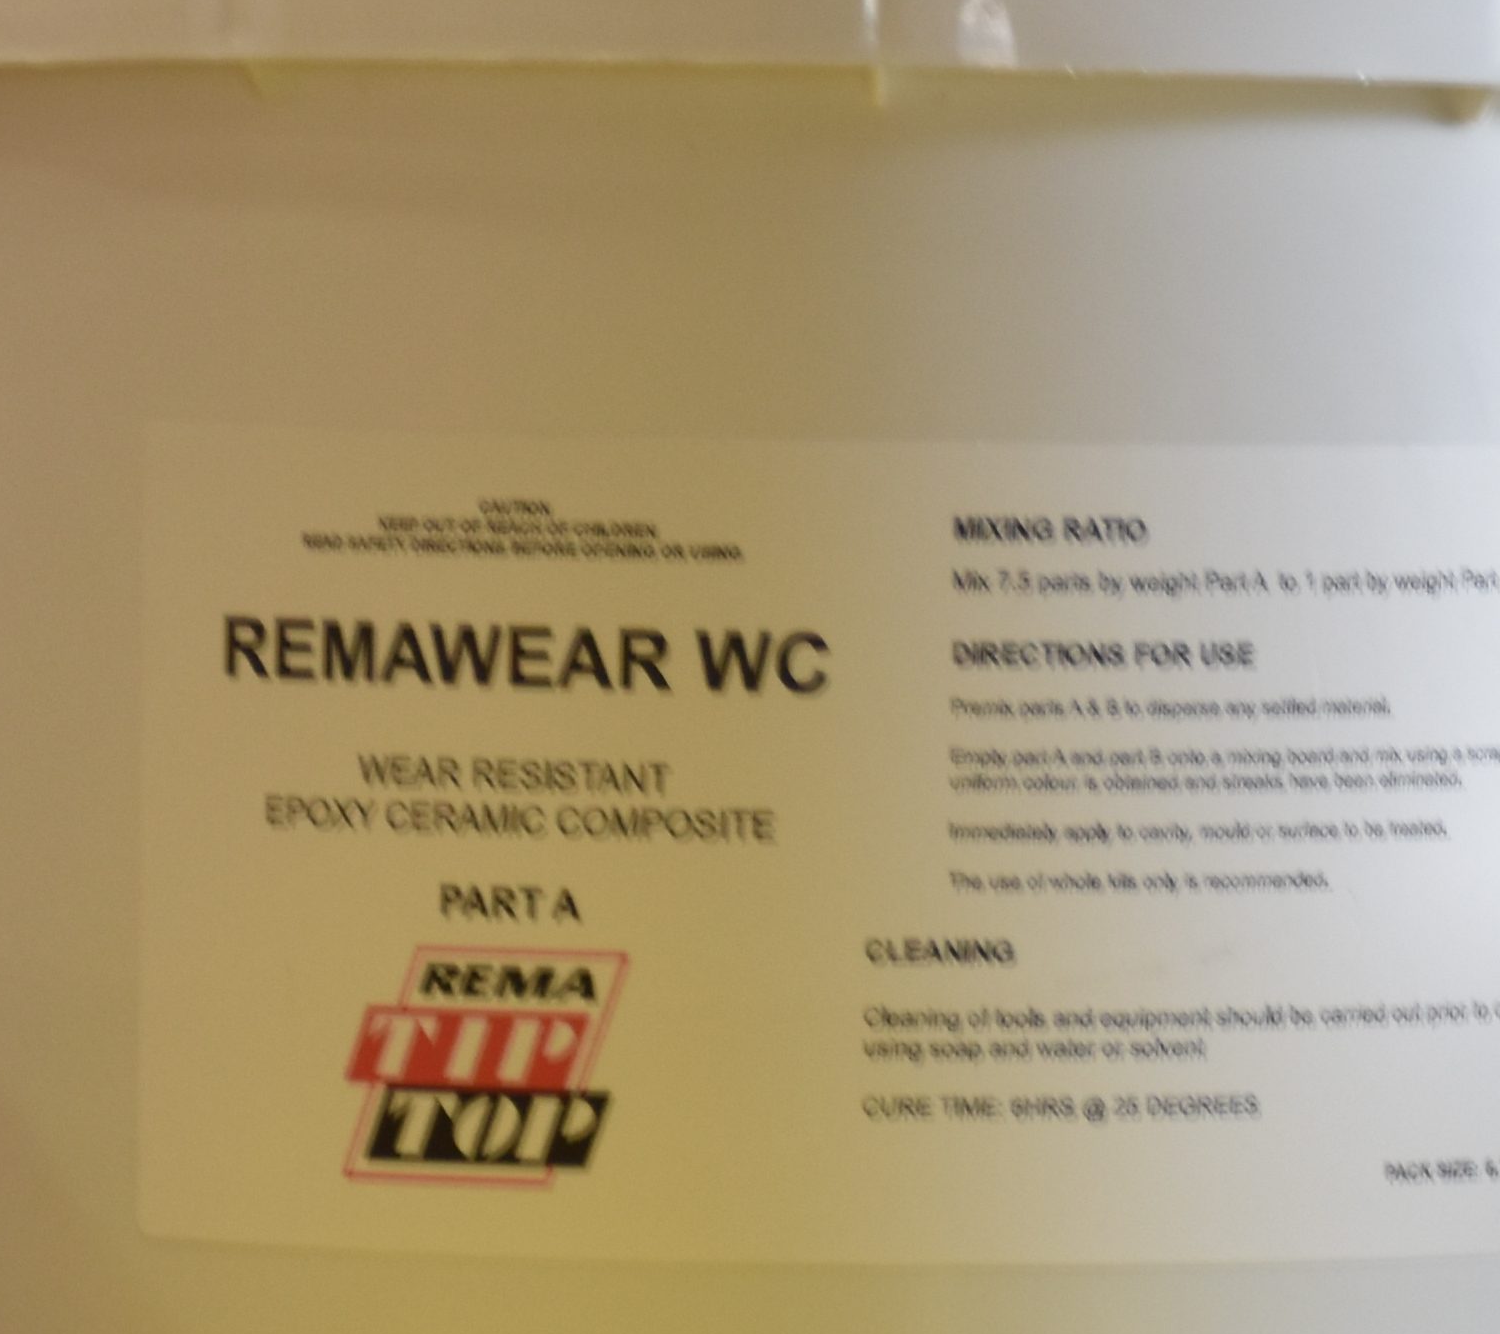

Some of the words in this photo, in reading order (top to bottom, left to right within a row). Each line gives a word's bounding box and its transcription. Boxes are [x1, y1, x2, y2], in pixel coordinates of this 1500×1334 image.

[952, 514, 1056, 544] MIXING
[1062, 514, 1150, 546] RATIO
[951, 569, 992, 597] Mix
[1037, 568, 1094, 597] parts
[1097, 568, 1125, 596] by
[1128, 568, 1200, 596] weight
[1204, 567, 1250, 596] Part
[1278, 567, 1300, 595] to
[1320, 567, 1362, 595] part
[1364, 567, 1390, 595] by
[1392, 566, 1457, 595] weight
[1459, 566, 1500, 594] Part
[222, 614, 672, 693] REMAWEAR
[697, 626, 831, 695] WC
[952, 639, 1127, 670] DIRECTIONS
[1133, 639, 1193, 670] FOR
[1199, 639, 1256, 670] USE
[357, 753, 461, 794] WEAR
[472, 758, 670, 798] RESISTANT
[264, 794, 375, 834] EPOXY
[386, 799, 545, 839] CERAMIC
[558, 805, 776, 846] COMPOSITE
[439, 881, 545, 922] PART
[552, 887, 582, 924] A
[864, 936, 1018, 966] CLEANING
[419, 961, 597, 1002] REMA
[363, 1013, 579, 1085] TIP
[384, 1089, 600, 1162] TOP
[861, 1092, 934, 1121] CURE
[1080, 1091, 1109, 1124] @
[1145, 1091, 1263, 1120] DEGREES
[1382, 1159, 1434, 1184] PACK
